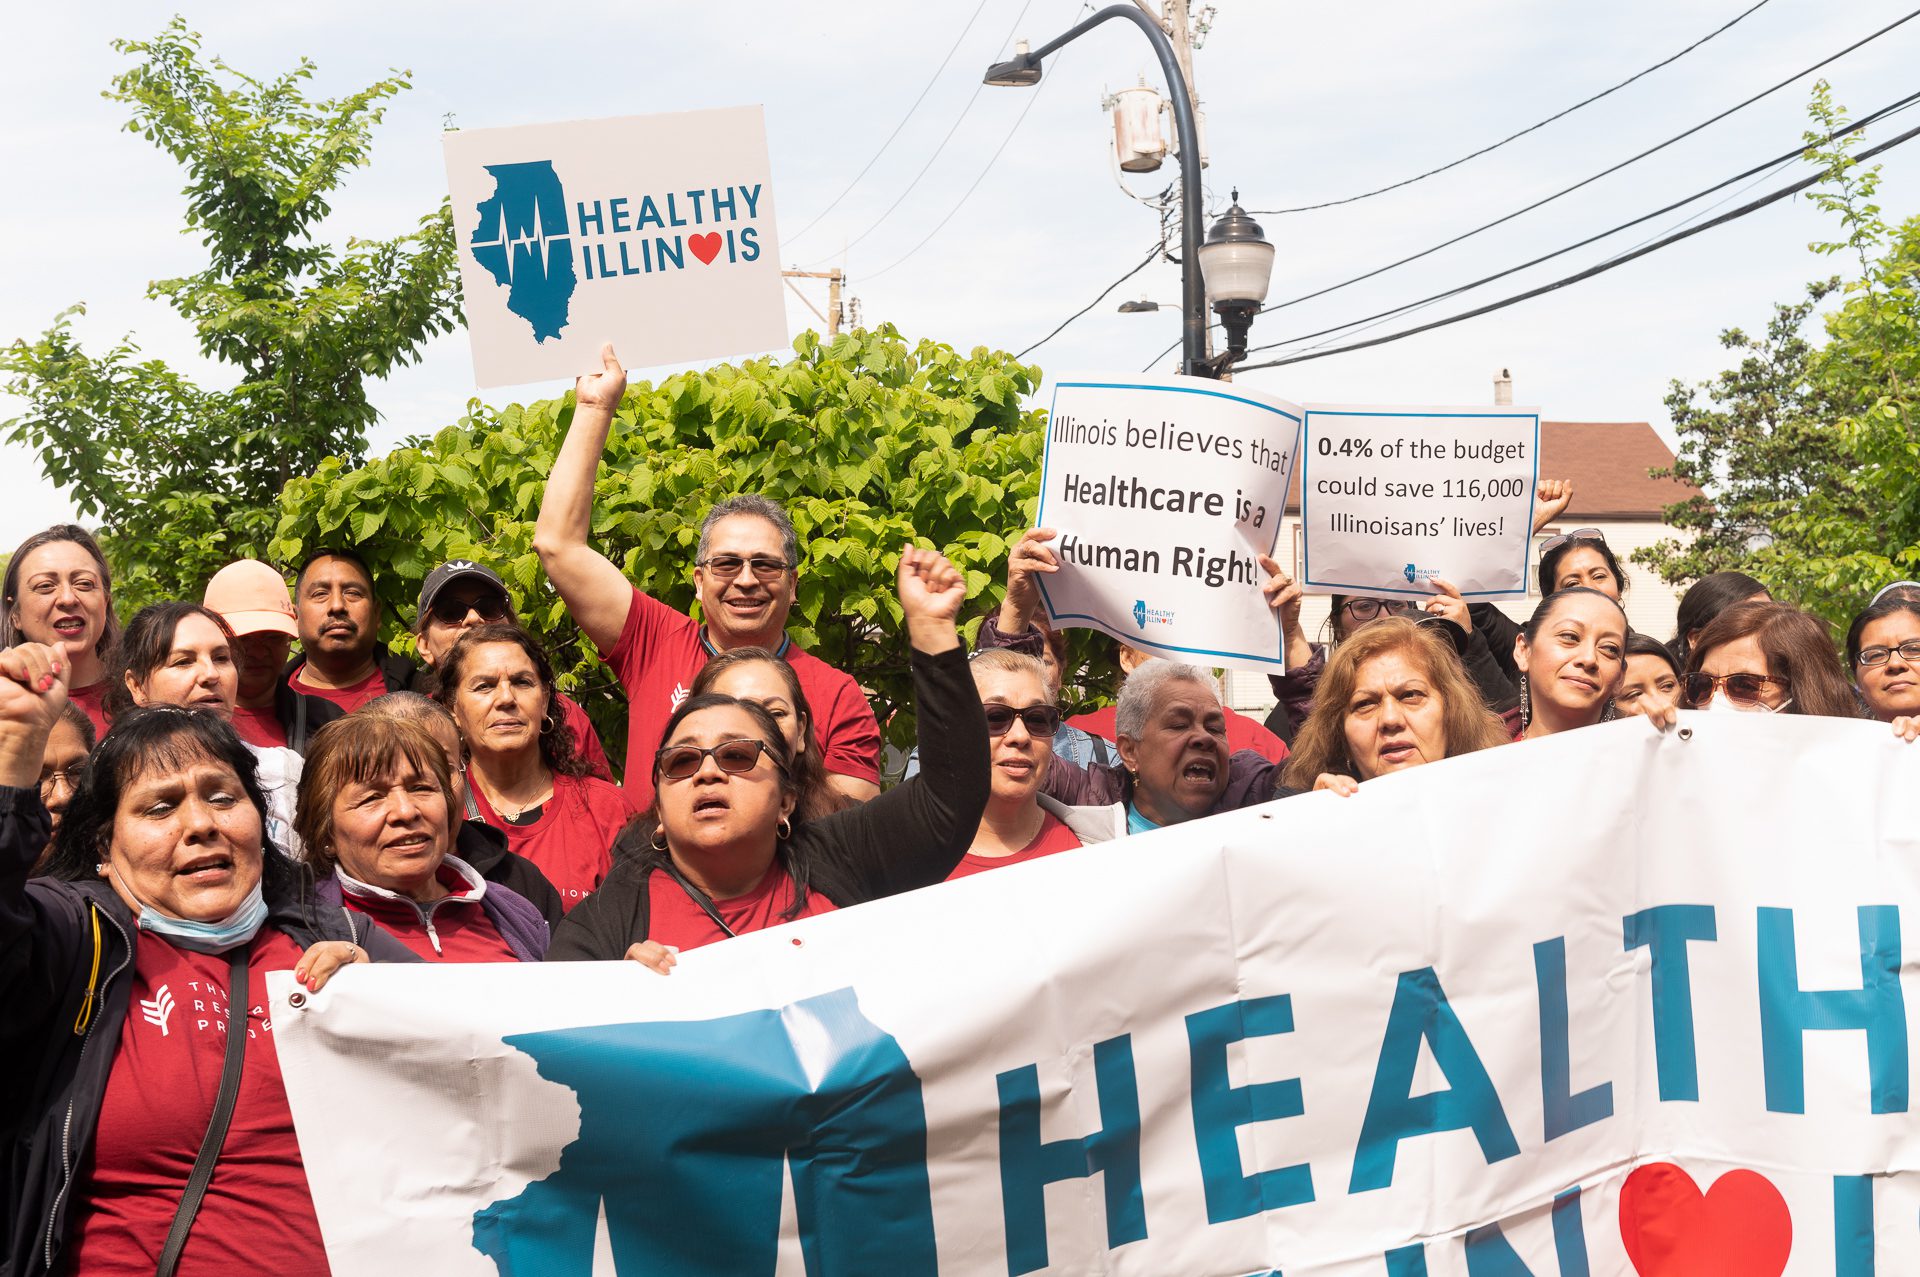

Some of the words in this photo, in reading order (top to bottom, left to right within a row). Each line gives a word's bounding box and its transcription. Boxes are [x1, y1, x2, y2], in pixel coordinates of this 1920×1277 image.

[577, 184, 762, 237] HEALTHY
[1053, 416, 1117, 446] Illinois
[1125, 419, 1243, 459] believes
[1251, 438, 1288, 475] that
[1317, 437, 1373, 458] 0.4%
[1380, 438, 1404, 459] of
[1410, 440, 1446, 459] the
[1453, 439, 1525, 464] budget
[1064, 473, 1224, 516] Healthcare
[1235, 489, 1251, 523] is
[1252, 505, 1266, 528] a
[1317, 476, 1377, 496] could
[1384, 482, 1434, 498] save
[1442, 478, 1524, 502] 116,000
[1330, 513, 1446, 537] Illinoisans’
[1453, 516, 1504, 537] lives!
[1060, 534, 1159, 574] Human
[1172, 546, 1258, 588] Right!
[1146, 609, 1175, 618] HEALTHY
[996, 904, 1910, 1275] HEALTH
